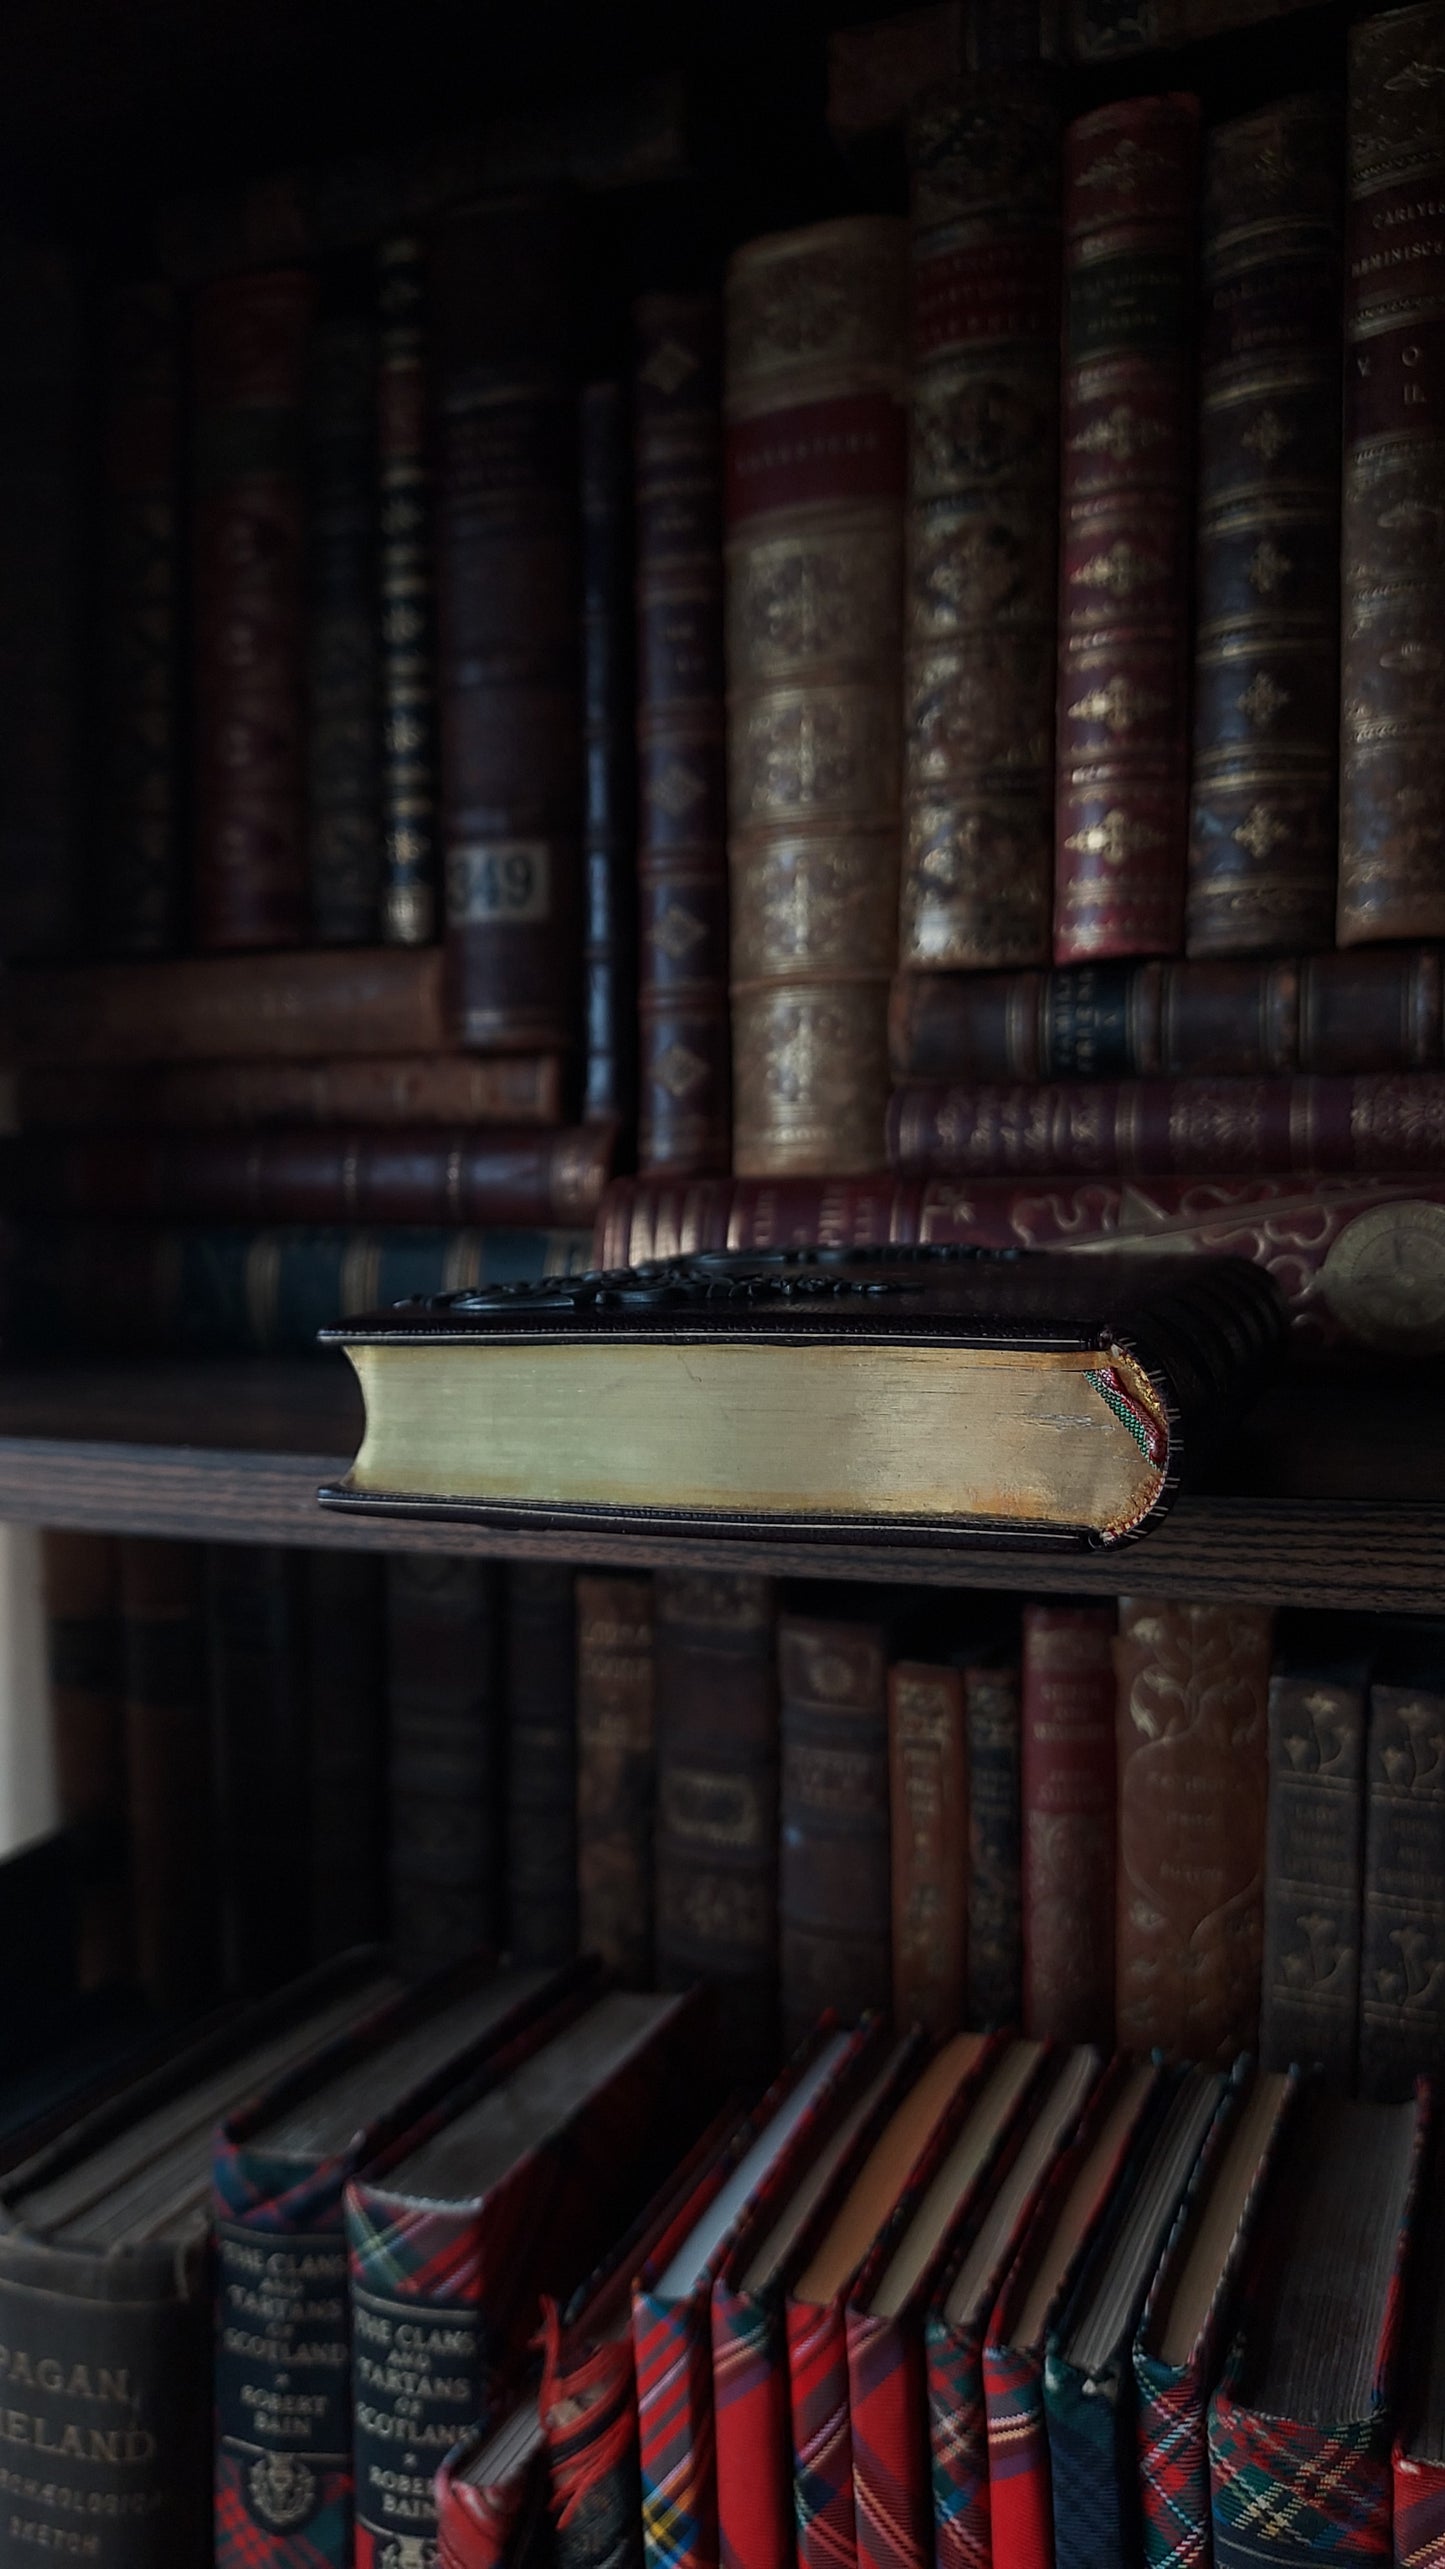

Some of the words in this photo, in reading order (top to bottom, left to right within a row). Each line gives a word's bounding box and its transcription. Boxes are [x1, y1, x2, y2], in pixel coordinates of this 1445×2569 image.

[227, 2284, 343, 2322] TARTANS
[223, 2327, 349, 2368] SCOTLAND
[265, 2321, 295, 2340] OF
[353, 2306, 393, 2346] THE
[394, 2323, 477, 2356] CLANS
[386, 2349, 432, 2373] AND
[356, 2356, 472, 2404] TARTANS
[240, 2384, 327, 2418] ROBERT
[394, 2396, 423, 2418] OF
[254, 2410, 312, 2438] BAIN
